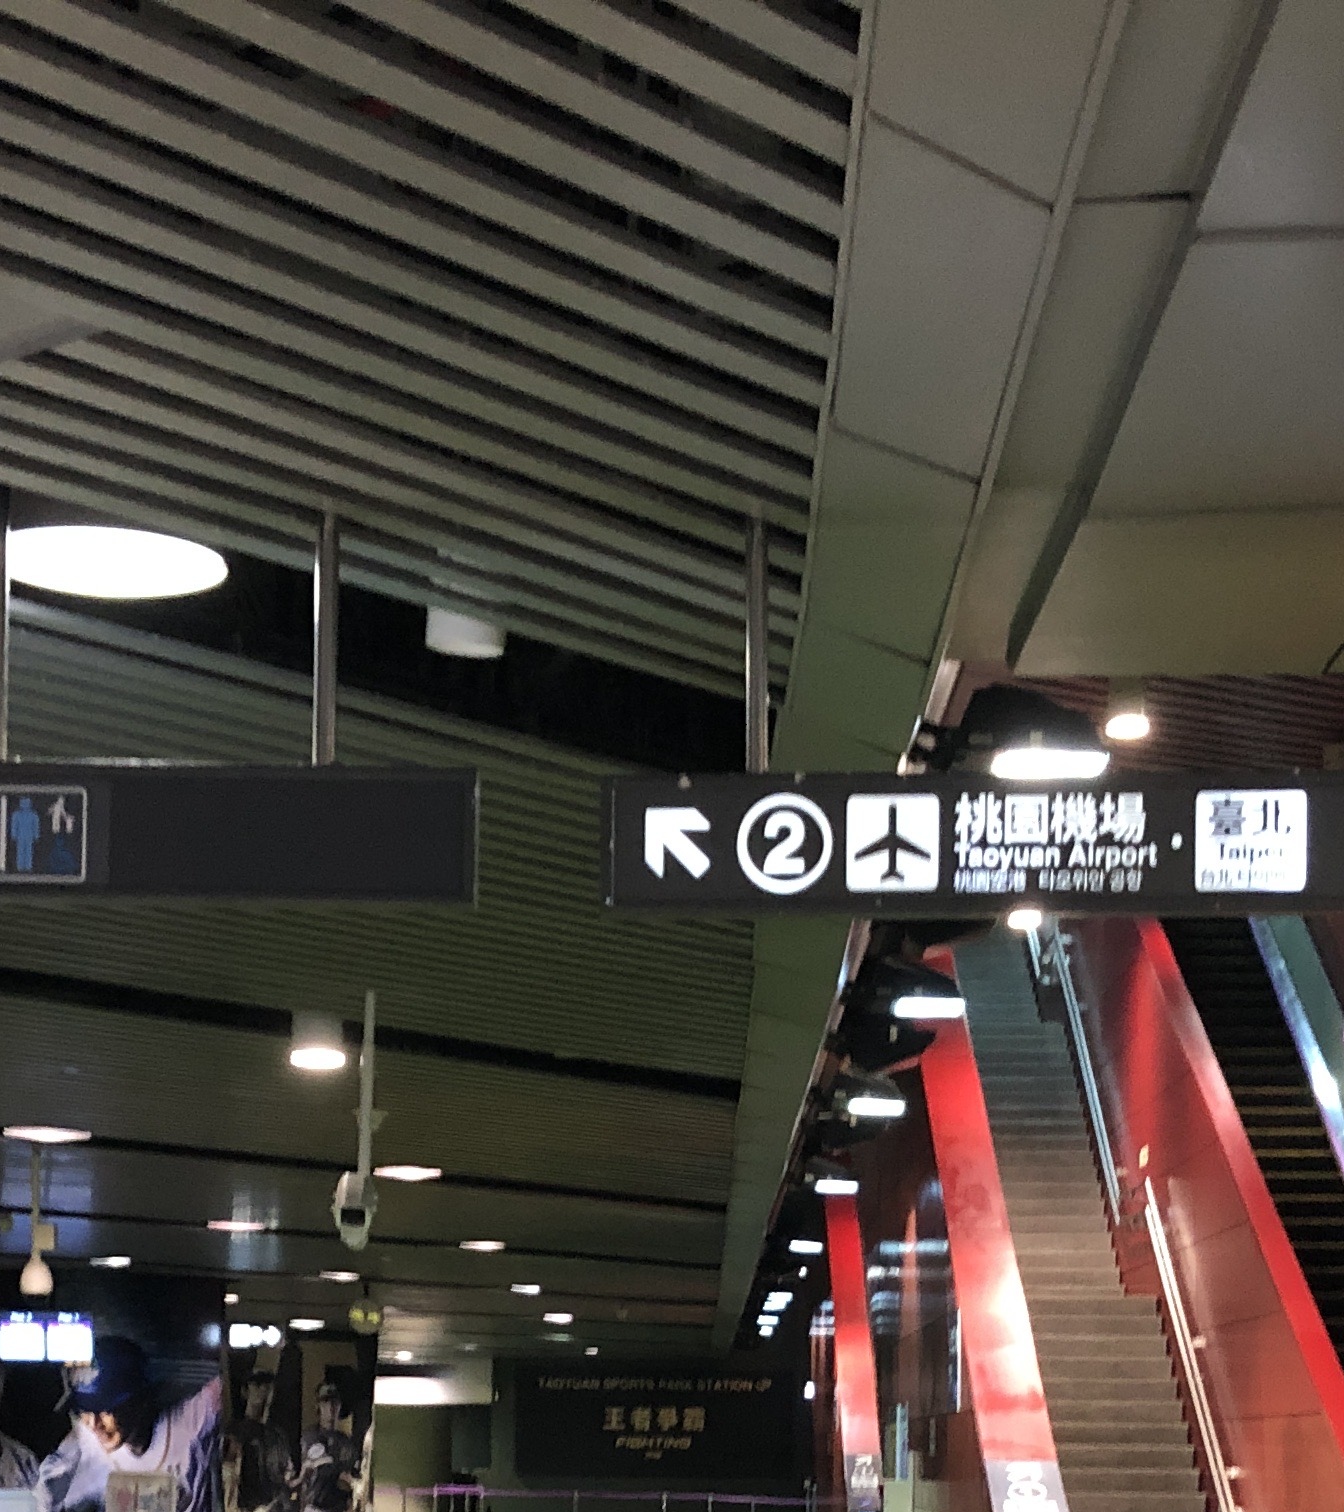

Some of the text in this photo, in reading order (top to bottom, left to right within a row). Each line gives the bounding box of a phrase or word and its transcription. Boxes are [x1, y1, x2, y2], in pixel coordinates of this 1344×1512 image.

[955, 792, 1145, 844] 桃園機場
[763, 823, 807, 875] 2
[955, 842, 1157, 873] Taoyuan Airport
